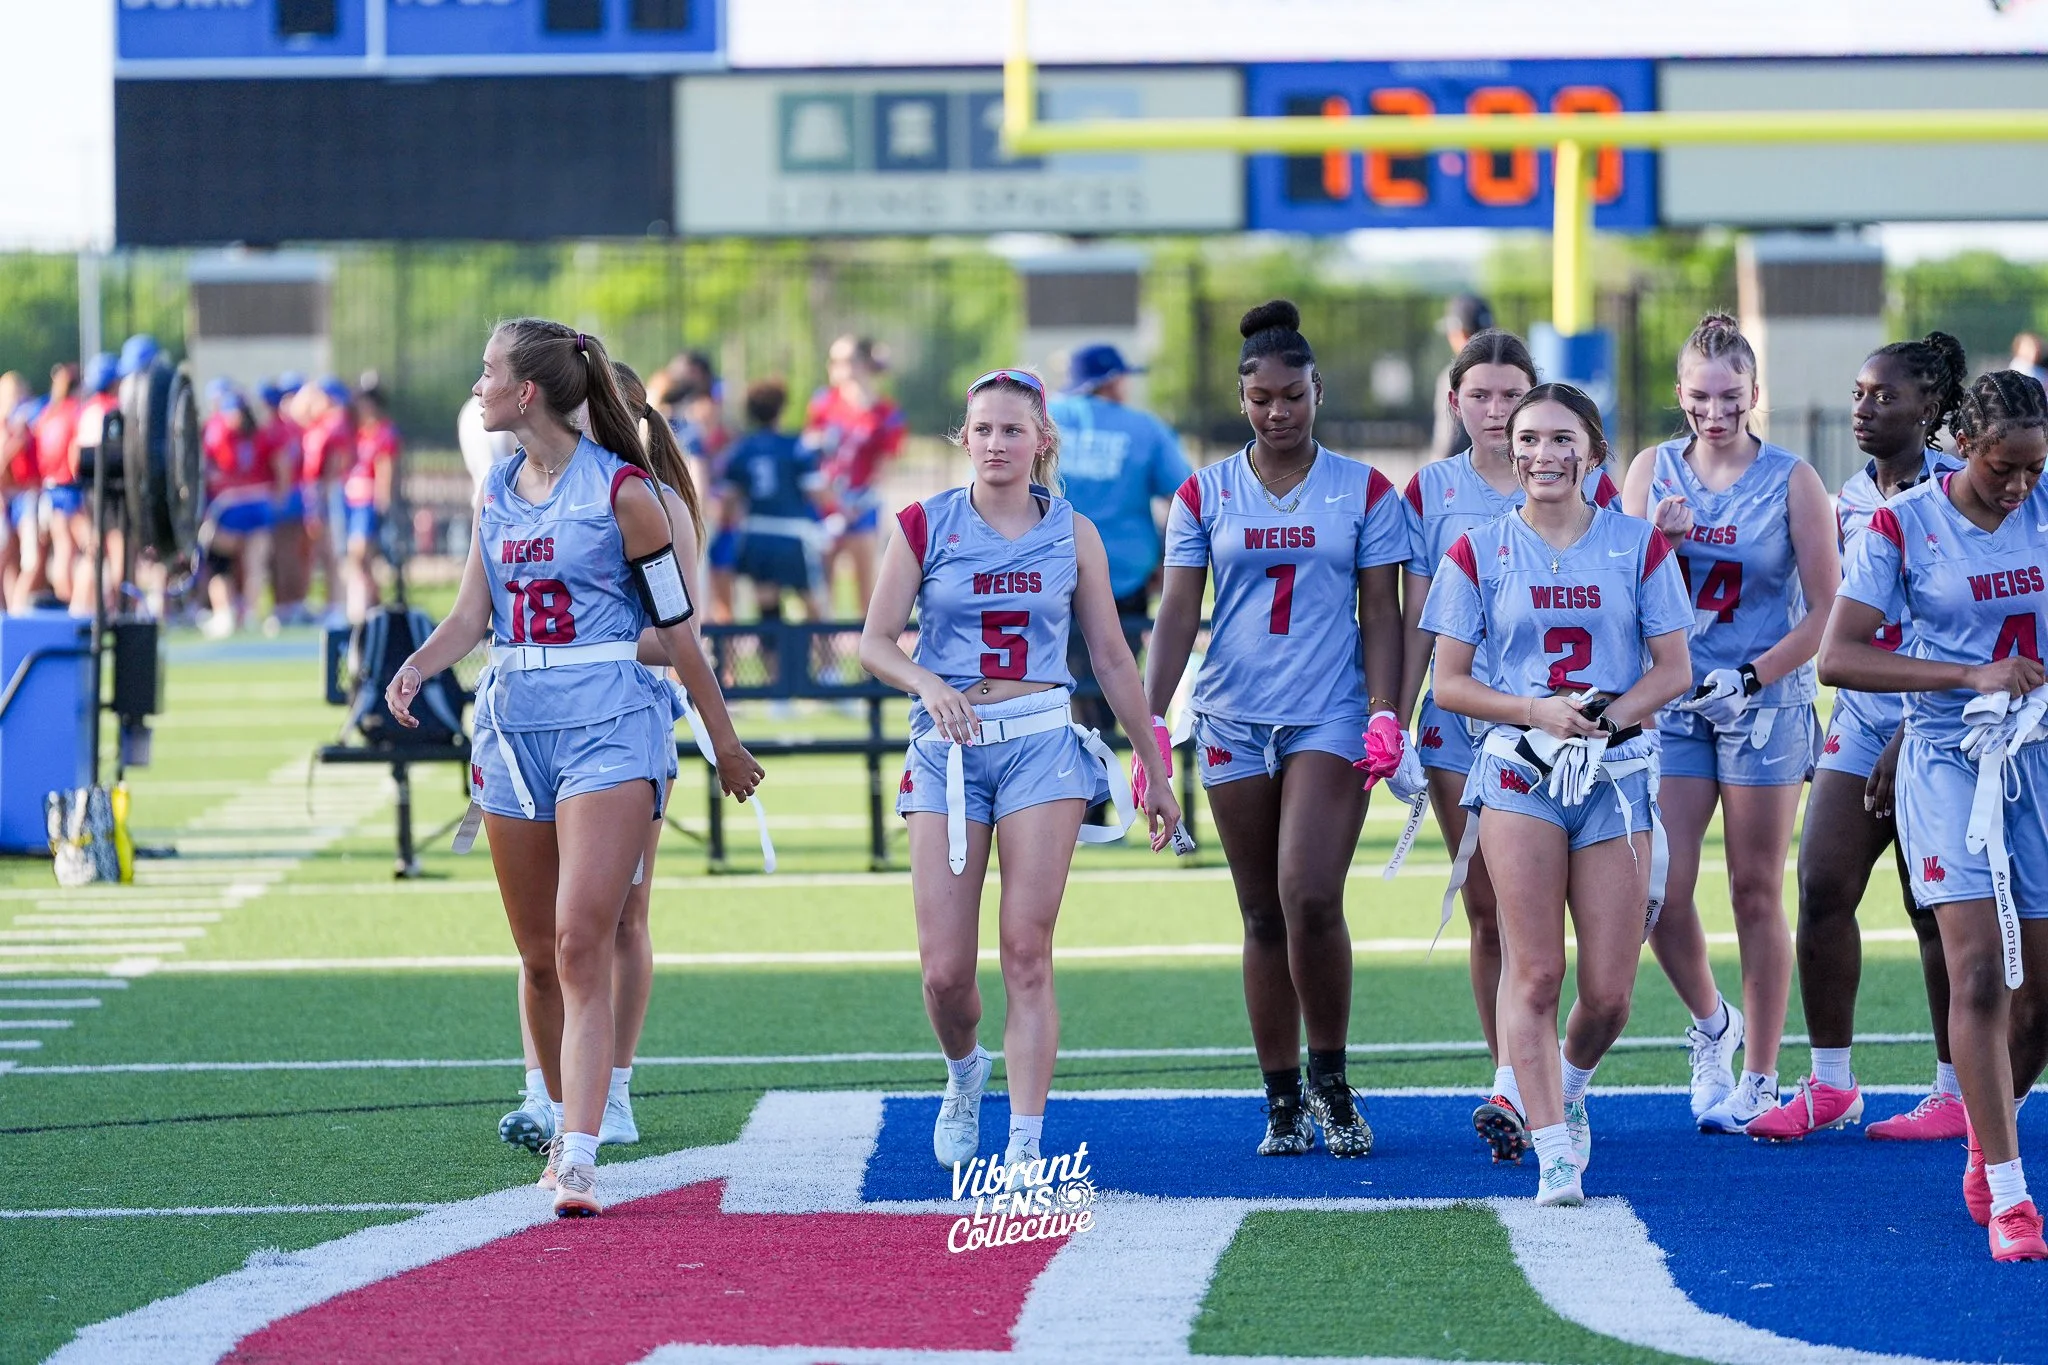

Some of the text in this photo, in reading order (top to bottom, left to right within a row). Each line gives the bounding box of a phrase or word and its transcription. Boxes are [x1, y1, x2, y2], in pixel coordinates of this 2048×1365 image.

[502, 538, 554, 564] WEISS
[1244, 526, 1316, 549] WEISS
[973, 572, 1042, 595] WEISS
[1266, 564, 1296, 635] 1
[1529, 585, 1601, 609] WEISS
[1967, 565, 2045, 602] WEISS
[505, 578, 576, 645] 18
[980, 611, 1030, 681] 5
[1544, 626, 1593, 691] 2
[1992, 612, 2044, 666] 4
[1412, 791, 1427, 819] USA
[1997, 882, 2018, 979] USA FOOTBALL
